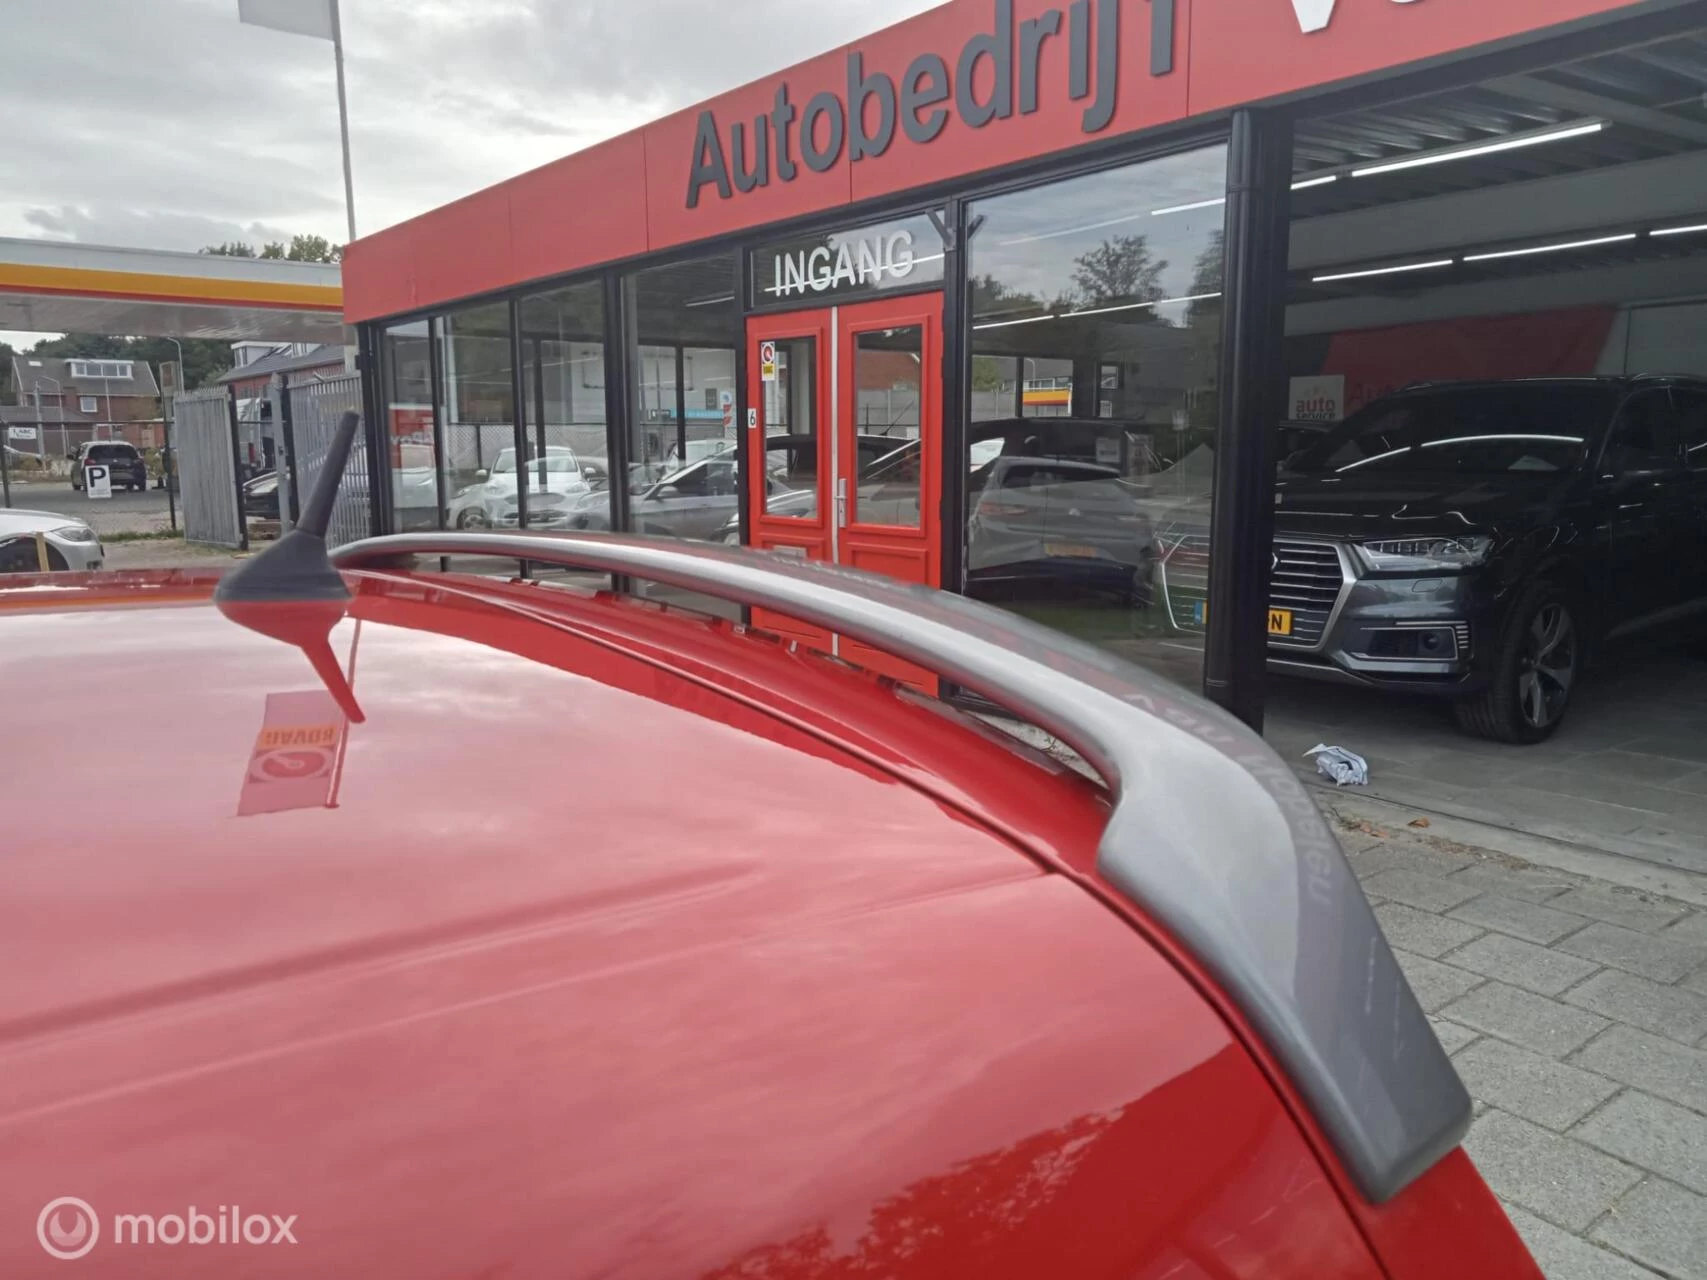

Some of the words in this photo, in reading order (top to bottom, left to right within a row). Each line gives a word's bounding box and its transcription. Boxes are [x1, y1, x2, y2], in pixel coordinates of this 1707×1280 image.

[774, 230, 913, 297] INGANG
[1296, 397, 1336, 412] auto
[750, 411, 756, 426] 6
[88, 467, 106, 488] P
